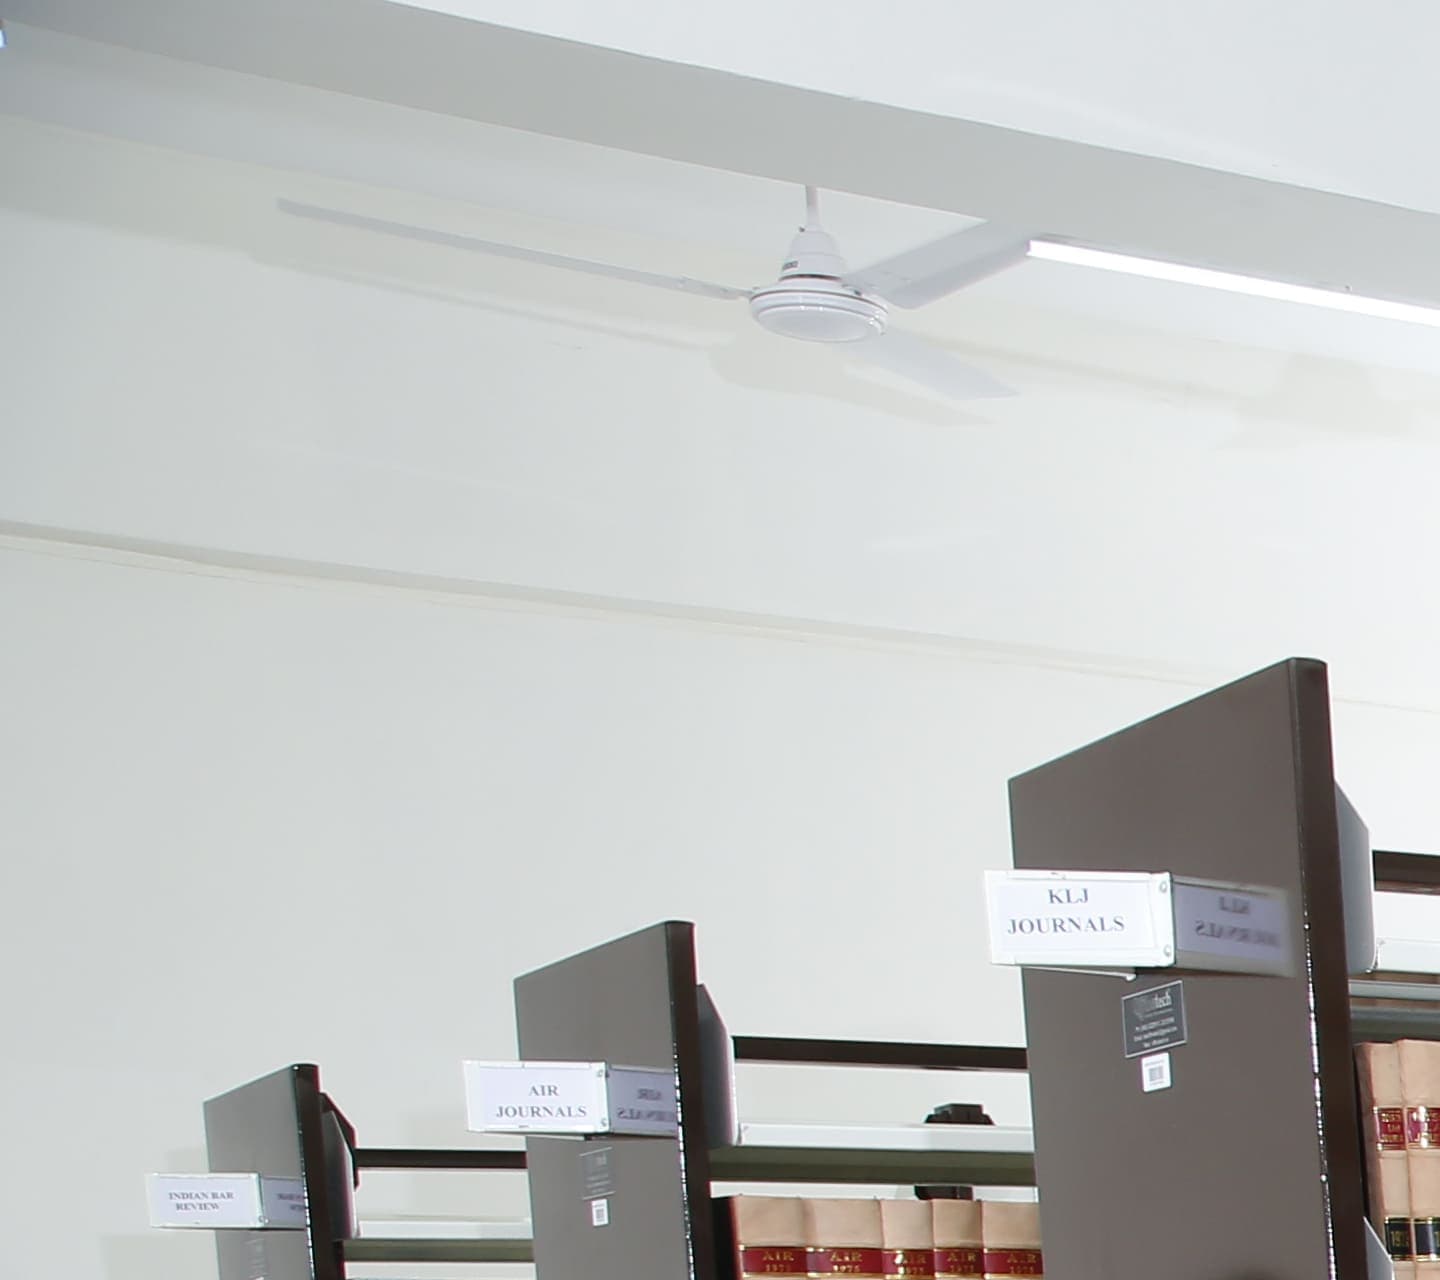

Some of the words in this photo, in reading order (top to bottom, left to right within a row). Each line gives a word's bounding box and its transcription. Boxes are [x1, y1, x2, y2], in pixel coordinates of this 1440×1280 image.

[1048, 888, 1088, 905] KLJ
[1008, 916, 1125, 935] JOURNALS
[529, 1085, 559, 1096] AIR
[496, 1106, 587, 1118] JOURNALS
[169, 1192, 209, 1200] INDIAN
[211, 1192, 234, 1200] BAR
[176, 1203, 219, 1211] REVIEW
[762, 1251, 794, 1262] AIR
